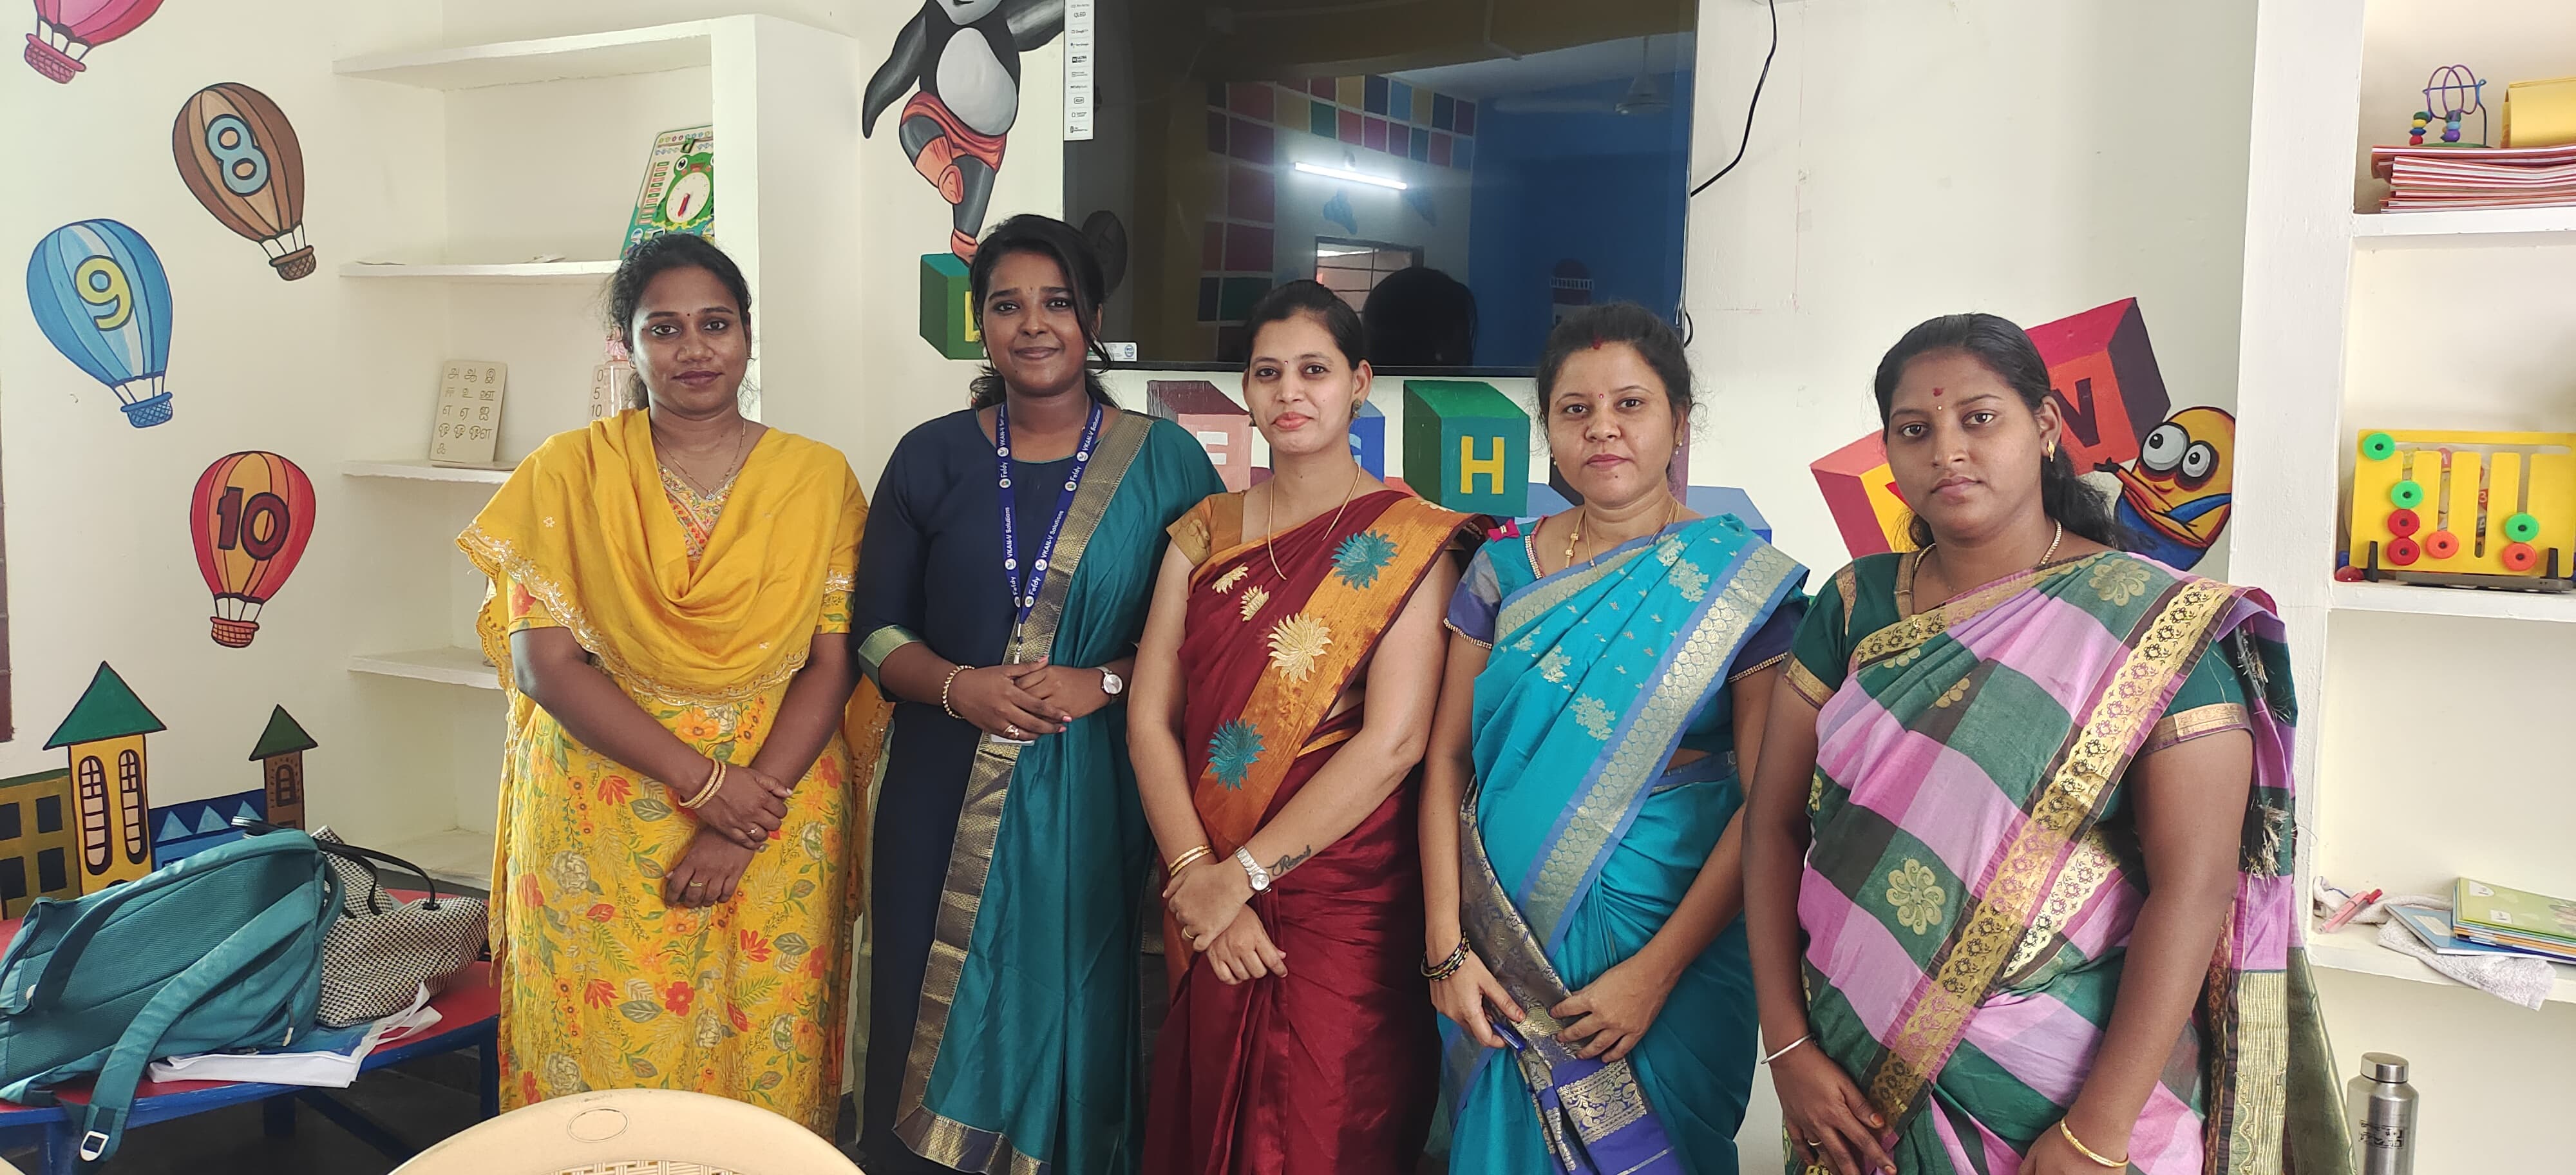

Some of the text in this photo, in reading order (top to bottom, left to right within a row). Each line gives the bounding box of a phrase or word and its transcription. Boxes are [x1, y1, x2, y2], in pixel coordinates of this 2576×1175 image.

[205, 113, 271, 197] 8
[74, 254, 134, 332] 9
[448, 367, 496, 384] அ ஆ இ
[597, 369, 603, 382] 0
[462, 388, 473, 398] உ
[593, 387, 601, 399] 5
[442, 405, 489, 421] எ ஏ ஐ
[591, 404, 602, 417] 10
[1460, 435, 1505, 495] H
[2479, 491, 2488, 503] 3
[217, 486, 290, 561] 10
[1050, 510, 1065, 535] Solutions
